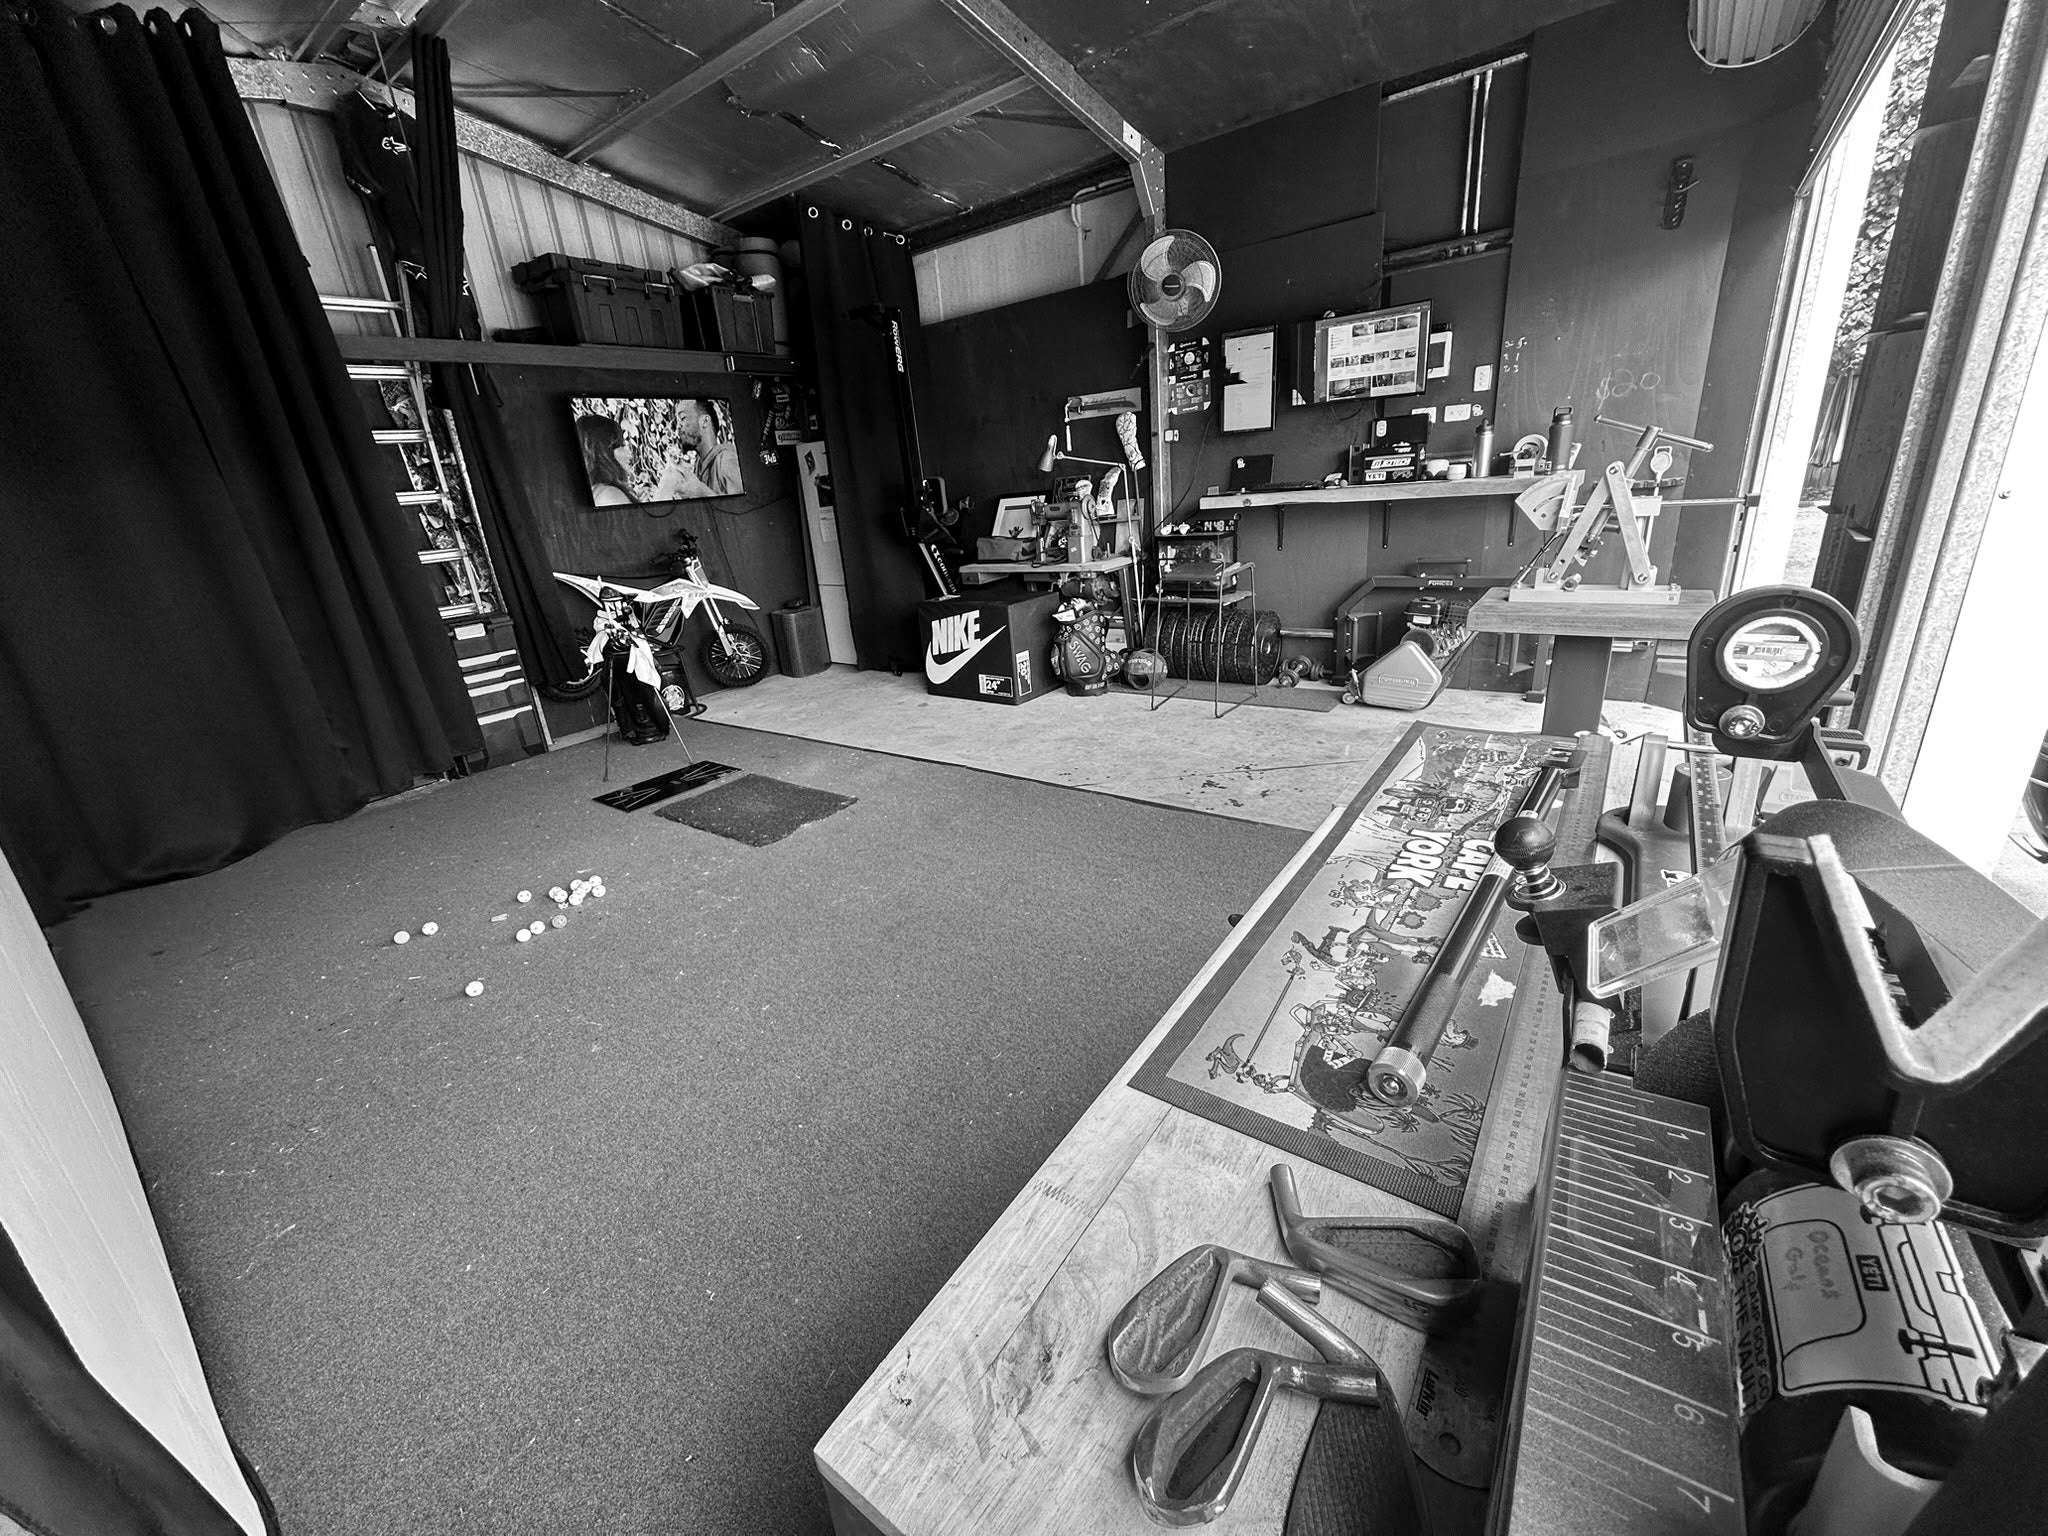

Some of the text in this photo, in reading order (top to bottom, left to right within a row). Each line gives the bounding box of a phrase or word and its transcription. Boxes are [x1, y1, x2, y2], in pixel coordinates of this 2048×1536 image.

[891, 320, 904, 372] ROWERG
[931, 609, 981, 656] NIKE
[1070, 640, 1092, 673] SWAG
[1386, 829, 1453, 888] YORK
[1443, 838, 1495, 891] CAPE
[1668, 1169, 1692, 1184] 2
[1668, 1217, 1694, 1232] 3
[1669, 1271, 1697, 1288] 4
[1859, 1257, 1884, 1288] YETI
[1672, 1332, 1705, 1352] 5
[1734, 1277, 1757, 1411] THE VAULT
[1754, 1325, 1768, 1368] GOLF
[1417, 1369, 1440, 1417] Lufkin
[1674, 1403, 1705, 1425] 6
[1677, 1486, 1710, 1514] 7
